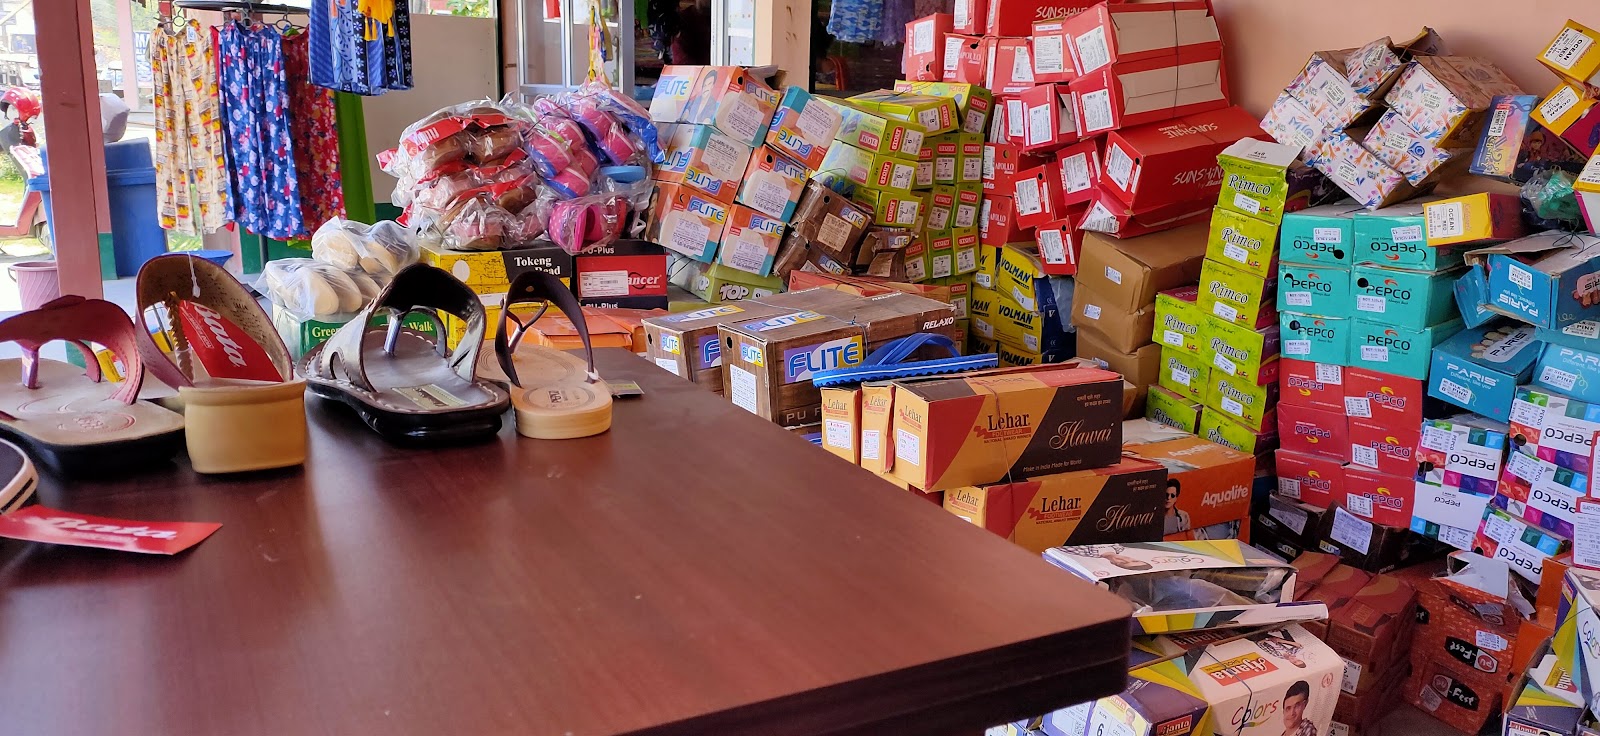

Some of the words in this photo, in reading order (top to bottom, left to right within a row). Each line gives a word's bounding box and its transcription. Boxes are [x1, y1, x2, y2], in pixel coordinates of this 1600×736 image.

[1563, 39, 1583, 61] OCEAN
[746, 82, 778, 106] FLITE
[778, 130, 813, 157] FLITE
[685, 169, 722, 191] FLITE
[776, 162, 808, 182] FLITE
[1173, 166, 1224, 186] SUNSHIN
[1228, 173, 1271, 195] Rimco
[690, 200, 725, 220] FLITE
[842, 206, 864, 226] FLITE
[751, 218, 784, 236] FLITE
[1222, 227, 1261, 251] Rimco
[1293, 239, 1335, 253] PEPCO
[1371, 242, 1417, 254] PEPCO
[514, 257, 552, 267] Tokeng
[1001, 256, 1031, 284] VOLMAN
[627, 275, 660, 286] ancer
[1291, 278, 1332, 293] PEPCO
[1209, 280, 1249, 304] Rimco
[1366, 284, 1411, 300] PEPCO
[998, 304, 1033, 324] VOLMAN
[1499, 293, 1539, 318] PARIS
[745, 311, 820, 331] FLITE
[923, 316, 954, 330] RELAXO
[1164, 314, 1198, 335] Rimco
[194, 303, 247, 369] Bata
[661, 335, 679, 351] FLITE
[1298, 326, 1335, 340] PEPCO
[1367, 334, 1411, 351] PEPCO
[1211, 337, 1249, 361] Rimco
[1490, 331, 1528, 356] PARIS
[741, 345, 762, 363] FLITE
[788, 342, 860, 378] FLITE
[1168, 357, 1199, 378] Rimco
[1446, 362, 1497, 387] PARIS
[1287, 377, 1325, 391] PEPCO
[1556, 375, 1574, 383] PINK
[870, 396, 887, 407] Lehar
[1218, 380, 1254, 405] Rimco
[1366, 390, 1406, 408] PEPCO
[827, 399, 848, 410] Lehar
[904, 405, 922, 424] Lehar
[786, 411, 806, 423] PU
[988, 413, 1030, 431] Lehar
[1154, 408, 1184, 430] Rimco
[1049, 419, 1115, 451] Hawai
[1295, 424, 1331, 439] PEPCO
[1371, 440, 1410, 458] PEPCO
[1450, 453, 1496, 471] PEPCO
[1296, 474, 1331, 491] PEPCO
[956, 489, 979, 507] Lehar
[1041, 496, 1081, 513] Lehar
[1201, 485, 1248, 508] Aqualite
[1363, 491, 1403, 509] PEPCO
[1434, 496, 1461, 508] PEPCO
[1096, 504, 1158, 532] Hawai
[1499, 547, 1543, 575] PEPCO
[1210, 657, 1266, 679] Ajanta
[1231, 700, 1280, 726] Colors
[1096, 723, 1105, 736] 6
